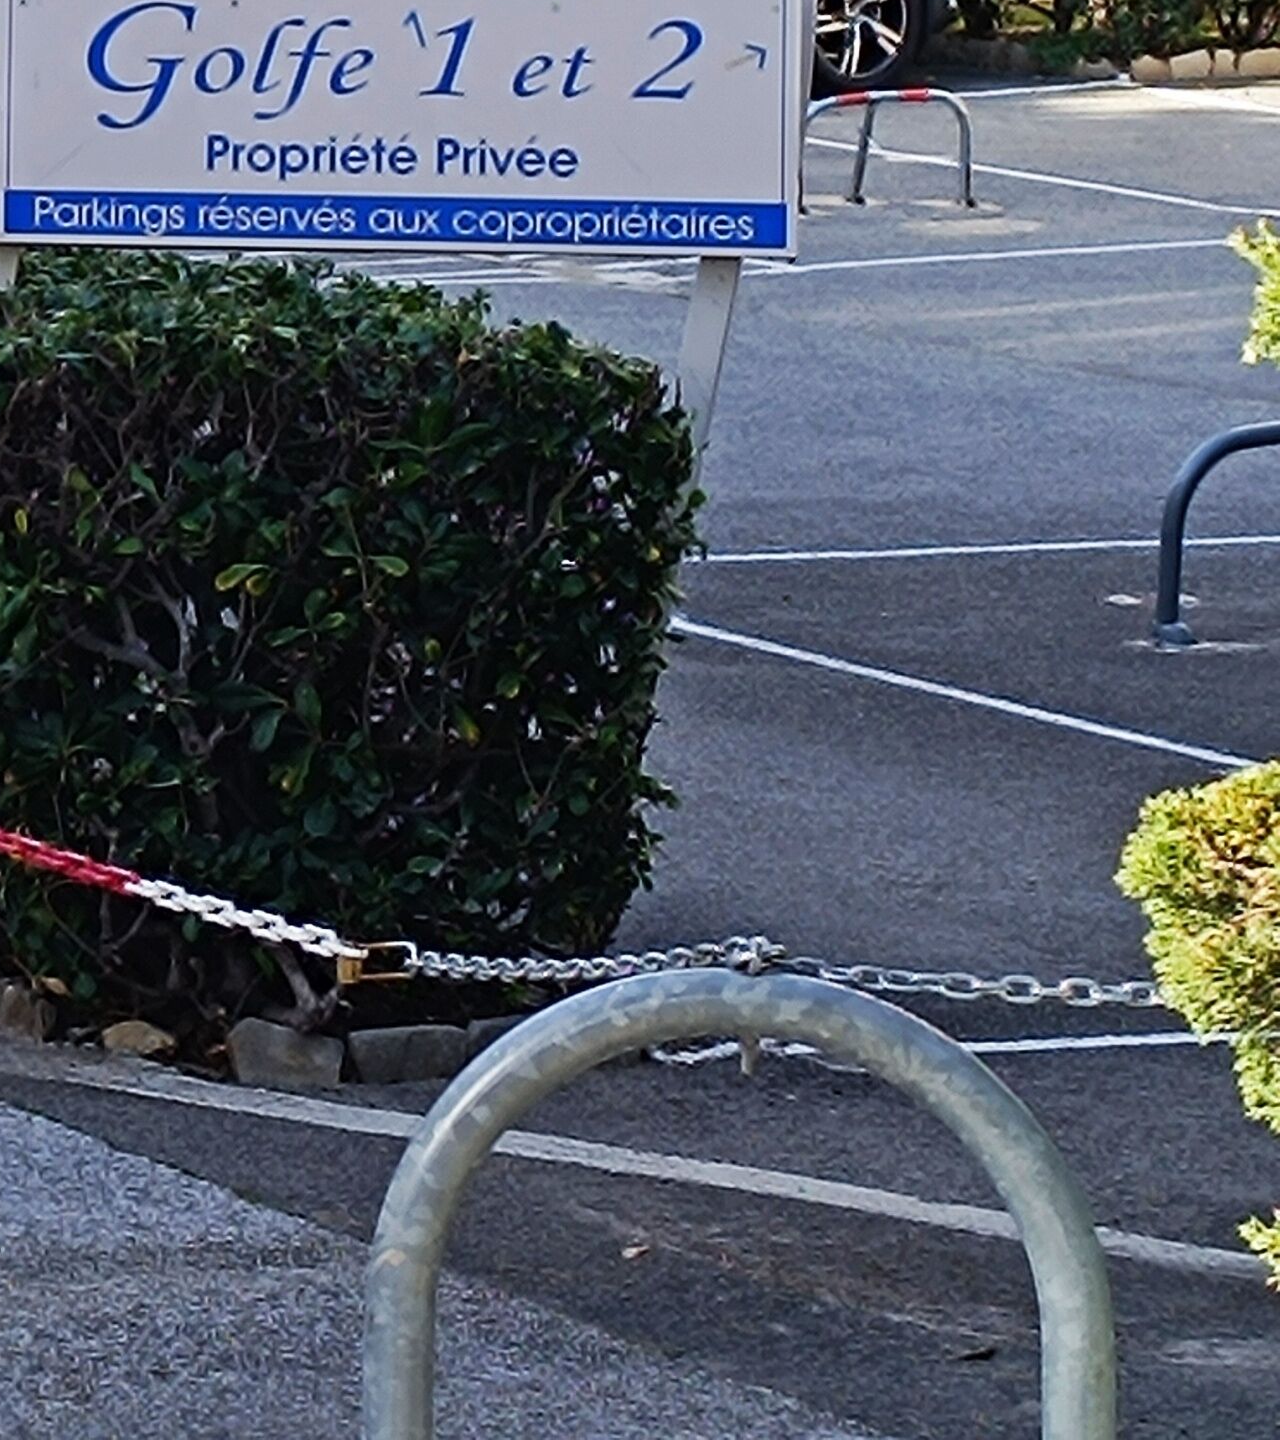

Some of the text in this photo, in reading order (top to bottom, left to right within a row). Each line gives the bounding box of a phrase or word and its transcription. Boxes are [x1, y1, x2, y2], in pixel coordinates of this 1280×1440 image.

[86, 1, 703, 130] Golfe 1 et 2
[206, 133, 579, 182] Propriété Privée
[34, 195, 755, 243] Parkings réservés aux copropriétaires
